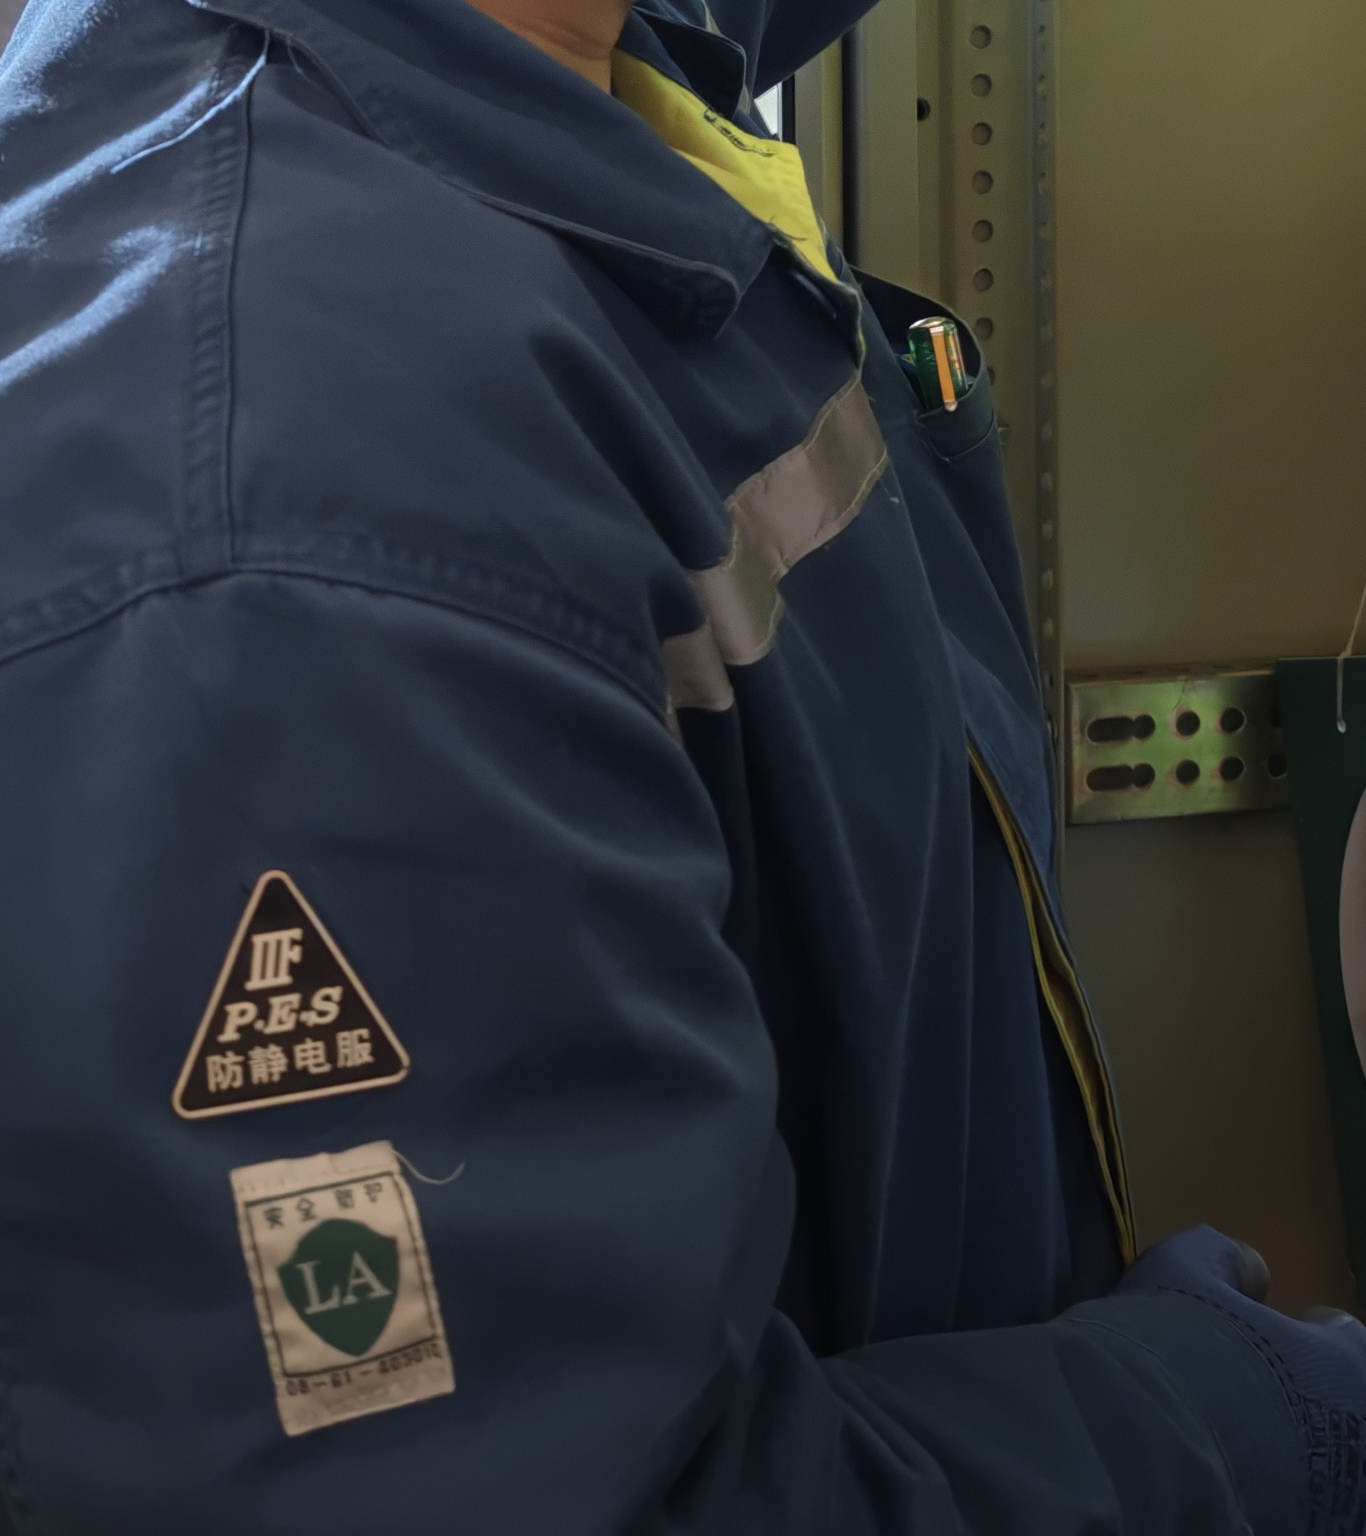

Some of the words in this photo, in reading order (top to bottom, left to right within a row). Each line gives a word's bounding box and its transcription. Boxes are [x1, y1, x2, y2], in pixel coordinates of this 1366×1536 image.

[205, 1027, 375, 1094] 防静电服
[295, 1250, 393, 1315] LA
